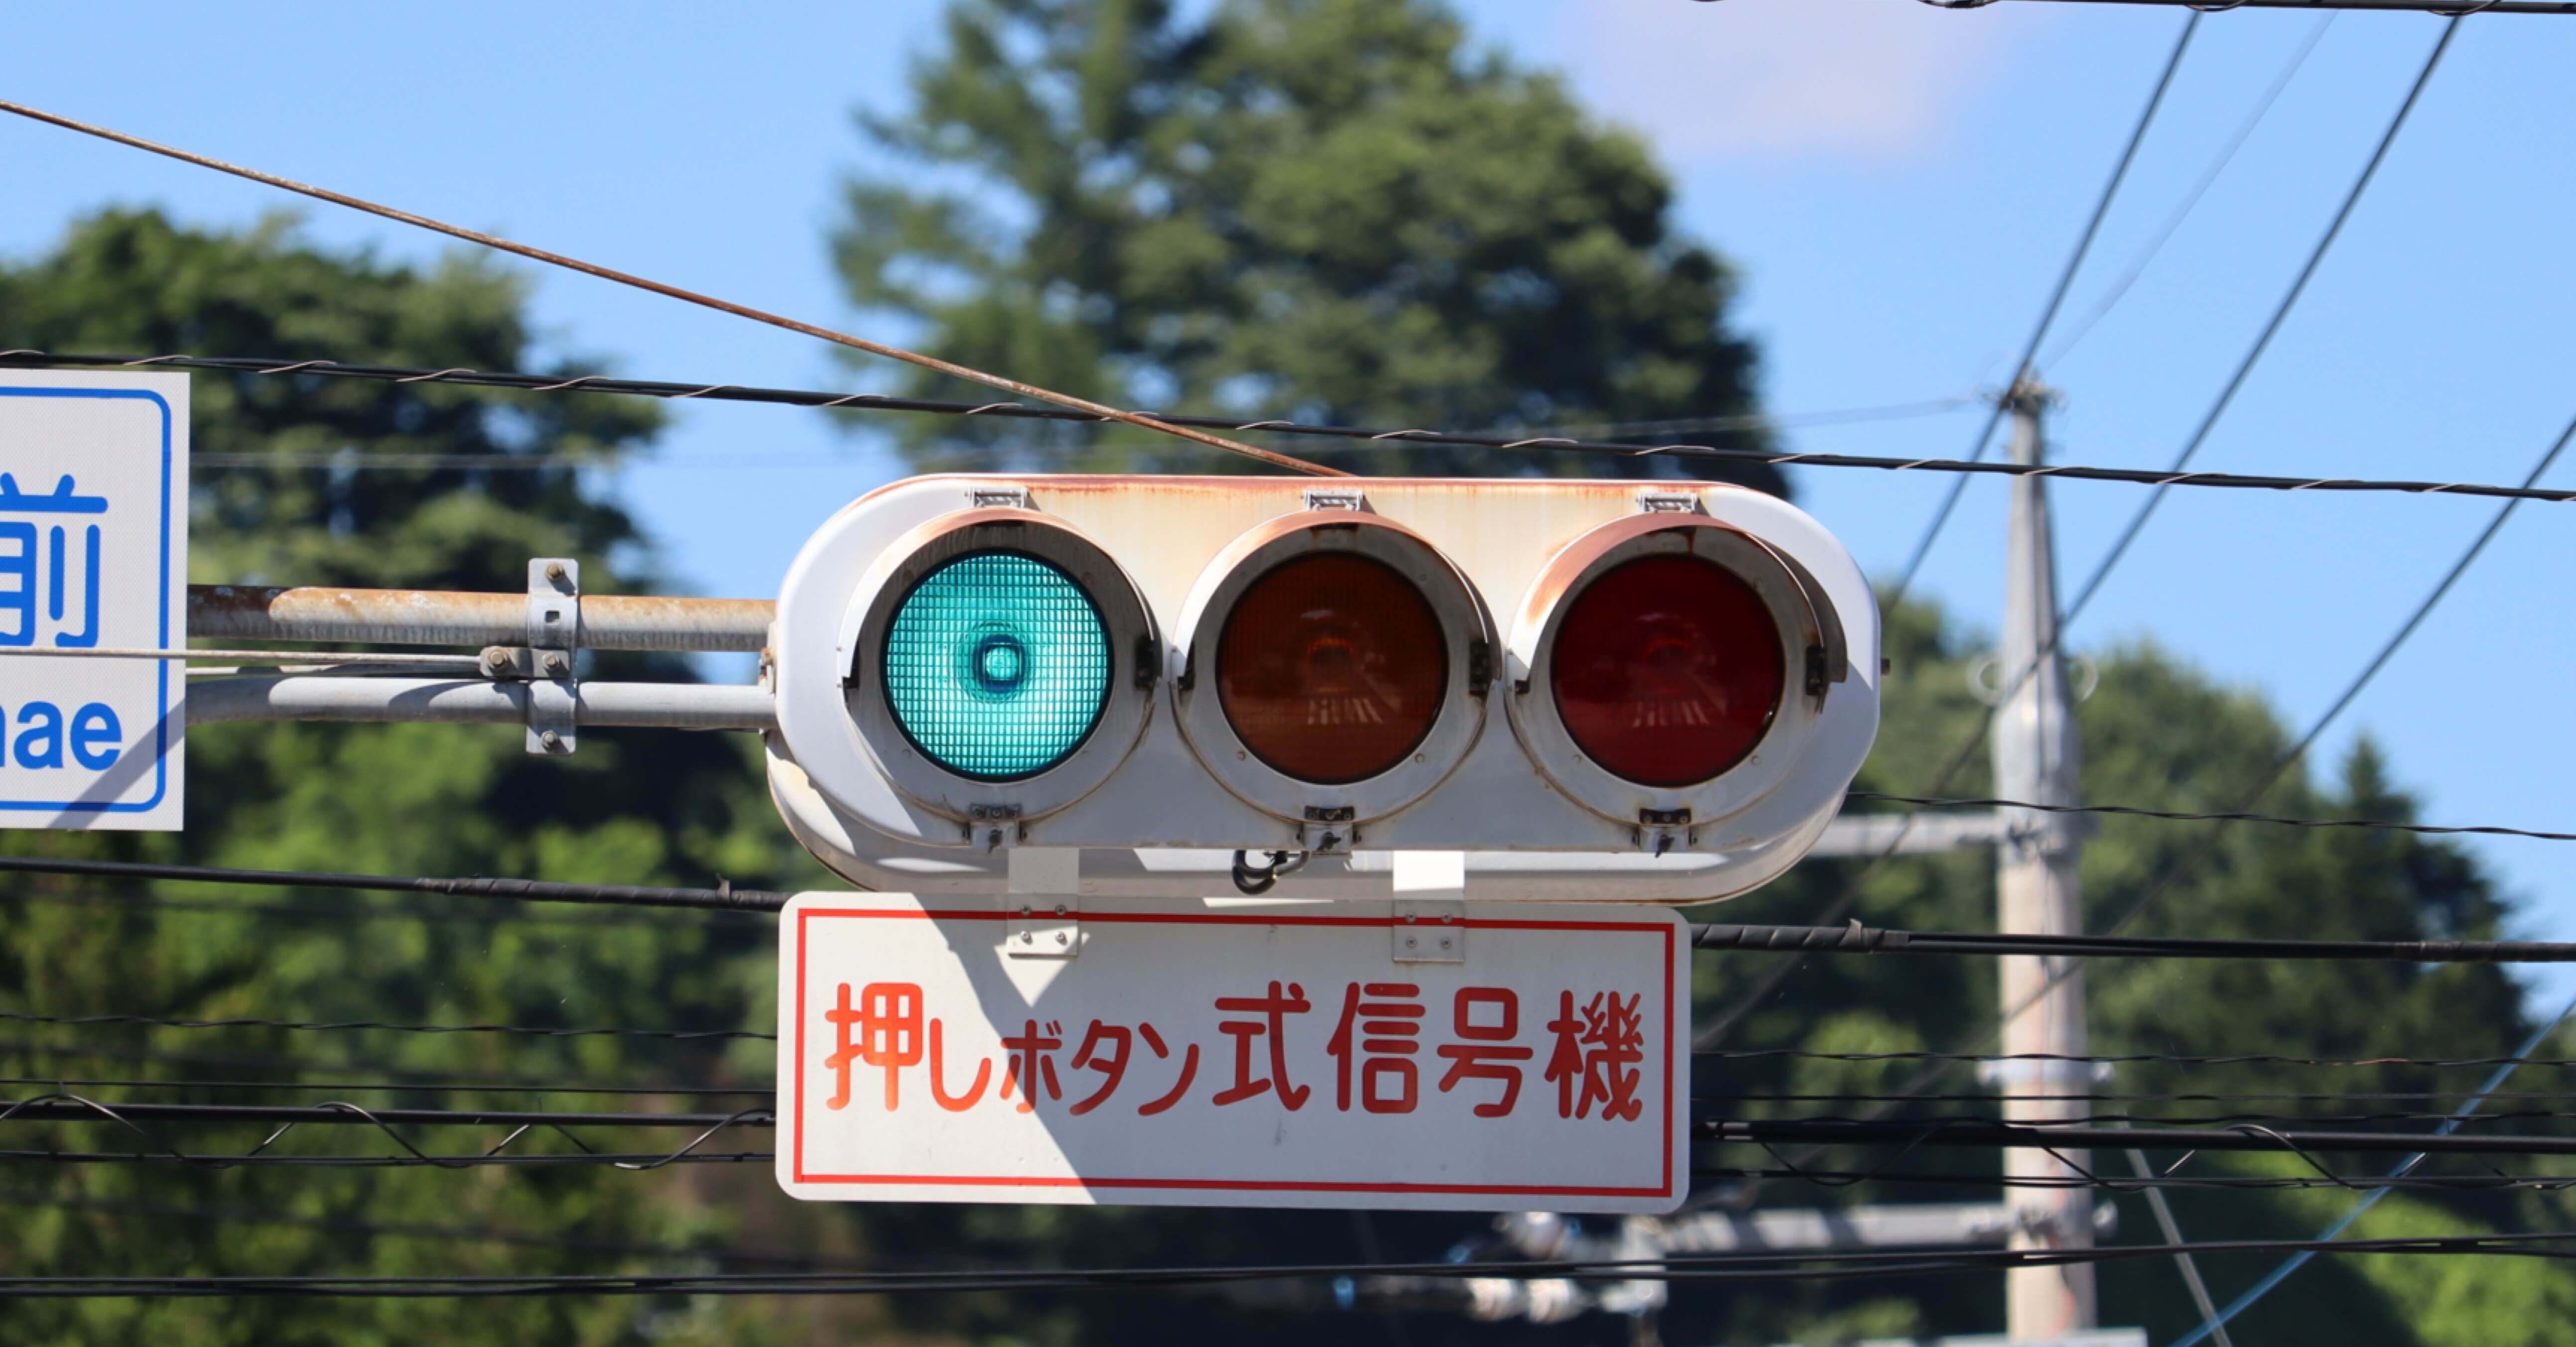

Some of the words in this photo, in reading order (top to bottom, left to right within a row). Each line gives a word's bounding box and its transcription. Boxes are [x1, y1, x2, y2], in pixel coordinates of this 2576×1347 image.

[0, 701, 122, 770] ae
[825, 981, 1643, 1121] 押しボタン式信号機
